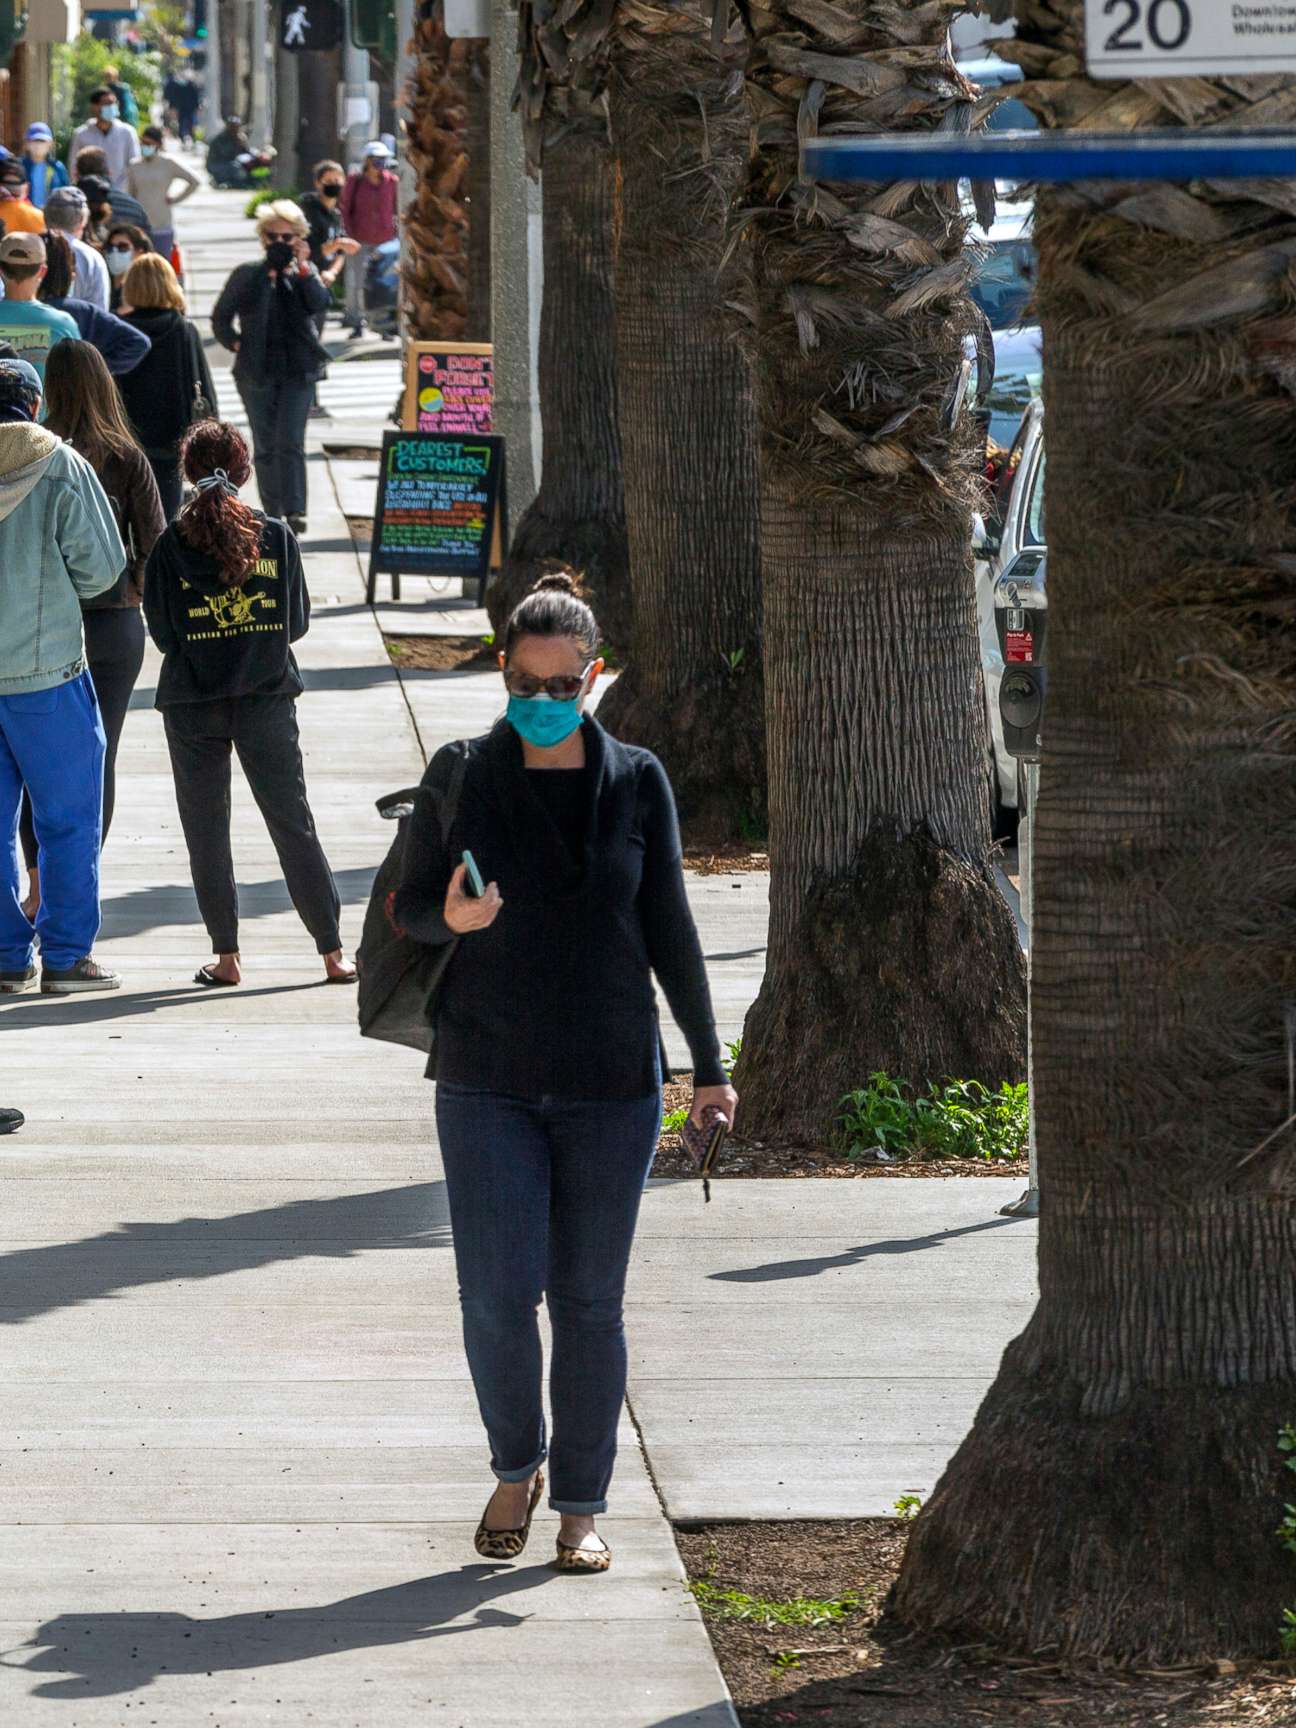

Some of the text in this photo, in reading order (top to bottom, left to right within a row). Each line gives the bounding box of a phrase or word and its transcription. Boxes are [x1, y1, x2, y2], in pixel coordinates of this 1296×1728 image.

[1232, 4, 1296, 19] Downtow
[1103, 0, 1191, 51] 20
[397, 441, 464, 457] DEAREST
[188, 606, 210, 618] WORLD
